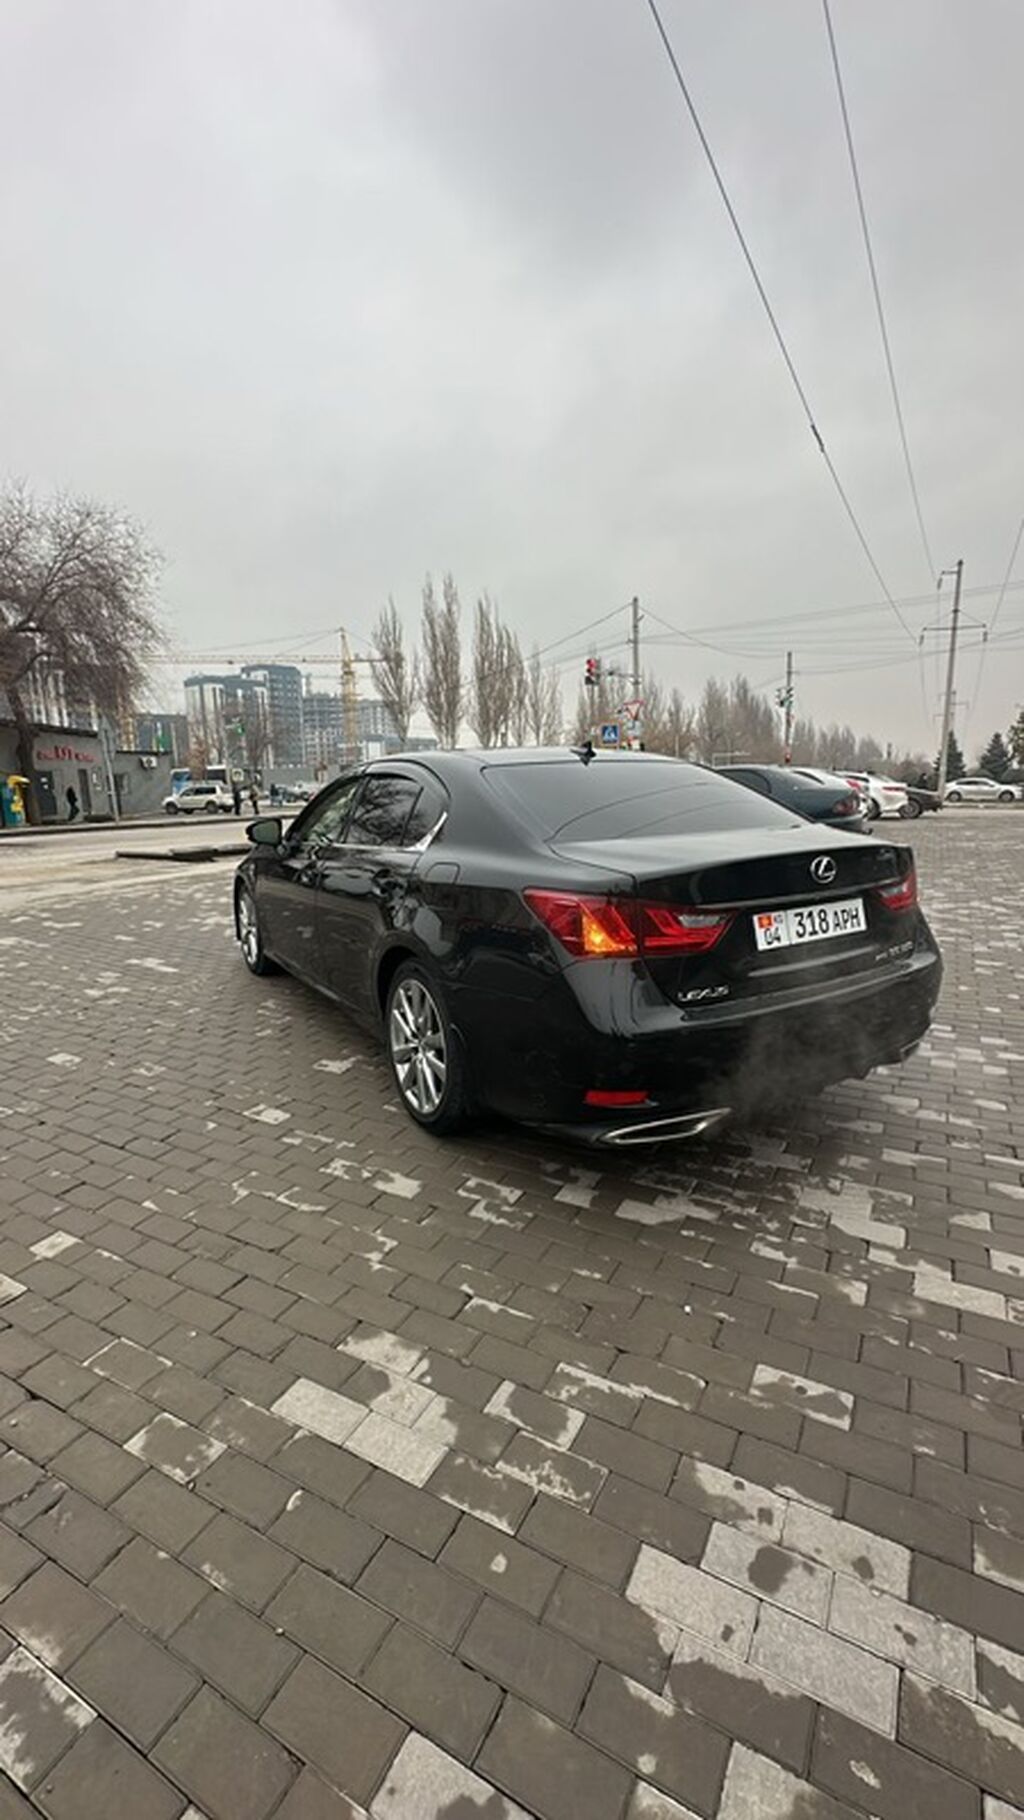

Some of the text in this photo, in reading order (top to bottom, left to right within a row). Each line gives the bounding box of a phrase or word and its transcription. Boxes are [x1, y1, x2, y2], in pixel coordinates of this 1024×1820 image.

[763, 907, 861, 945] 04 318 APH
